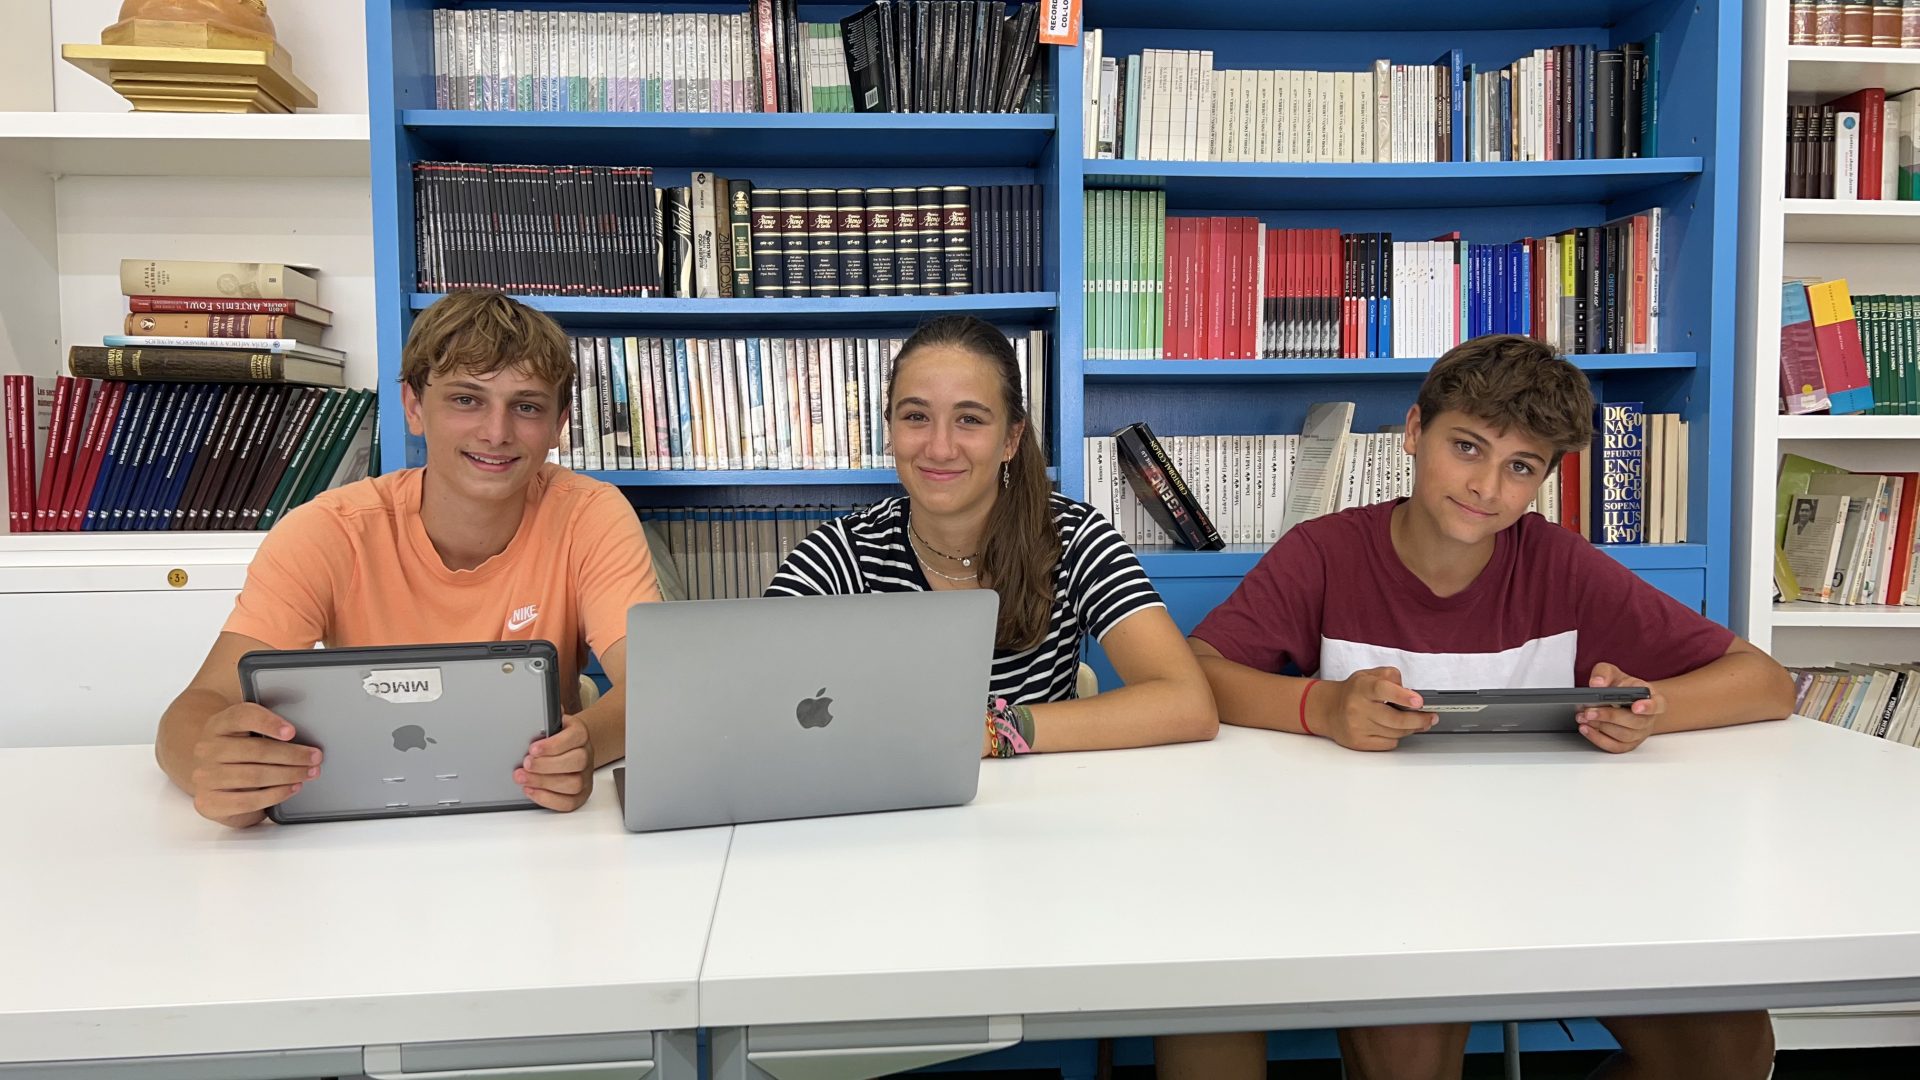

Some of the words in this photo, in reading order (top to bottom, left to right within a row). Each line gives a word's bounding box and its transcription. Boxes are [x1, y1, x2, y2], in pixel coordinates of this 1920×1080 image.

[764, 61, 772, 79] WEST
[765, 80, 774, 105] MORRIS
[671, 200, 691, 236] Nadal
[183, 302, 213, 311] FOWL
[216, 302, 260, 311] ARTEMIS
[1608, 298, 1614, 306] ES
[1608, 324, 1614, 332] LA
[1141, 450, 1148, 458] LU
[1150, 440, 1166, 463] COLON
[1604, 502, 1641, 510] SOPENA
[174, 574, 180, 582] 3
[512, 604, 537, 623] NIKE
